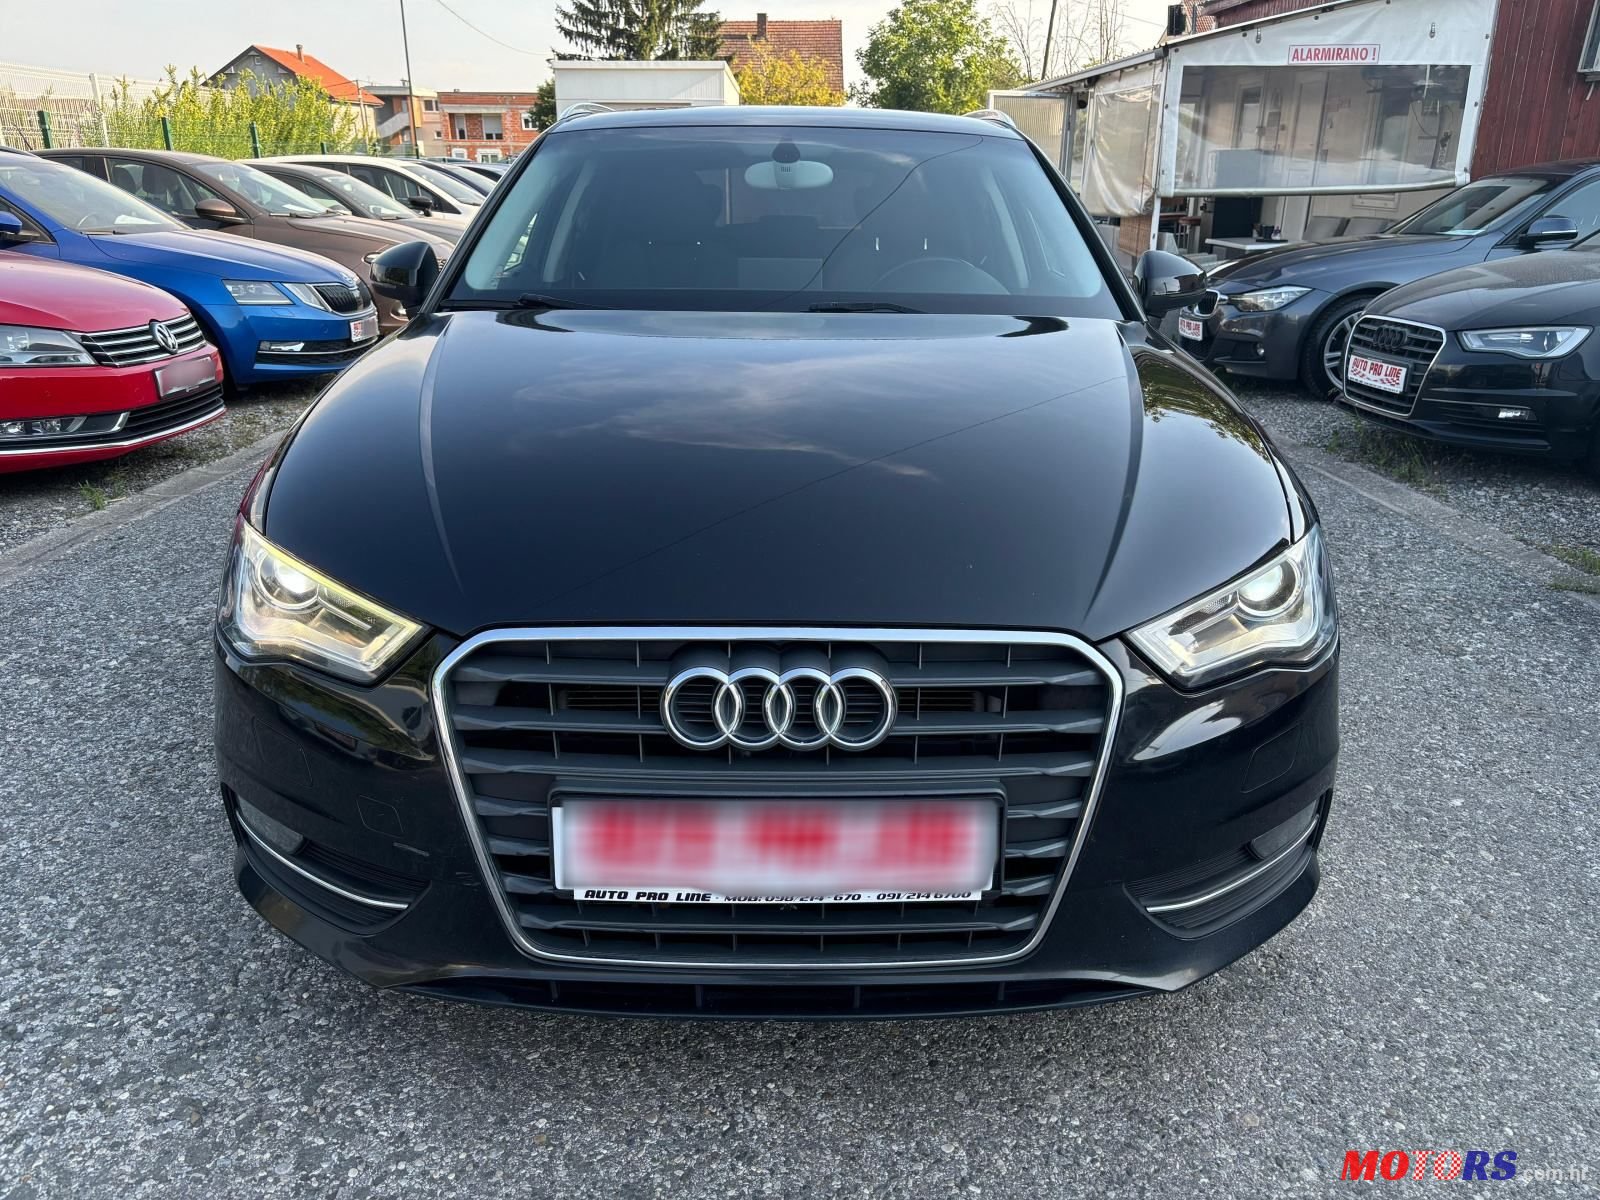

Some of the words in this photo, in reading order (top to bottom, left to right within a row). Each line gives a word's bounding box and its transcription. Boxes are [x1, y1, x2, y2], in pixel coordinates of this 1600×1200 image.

[1292, 47, 1368, 61] ALARMIRANO
[1353, 358, 1367, 371] AUTO
[1369, 362, 1383, 376] PRO
[1384, 366, 1402, 378] LINE
[584, 889, 629, 900] AUTO
[635, 891, 669, 901] PRO
[675, 892, 712, 902] LINE
